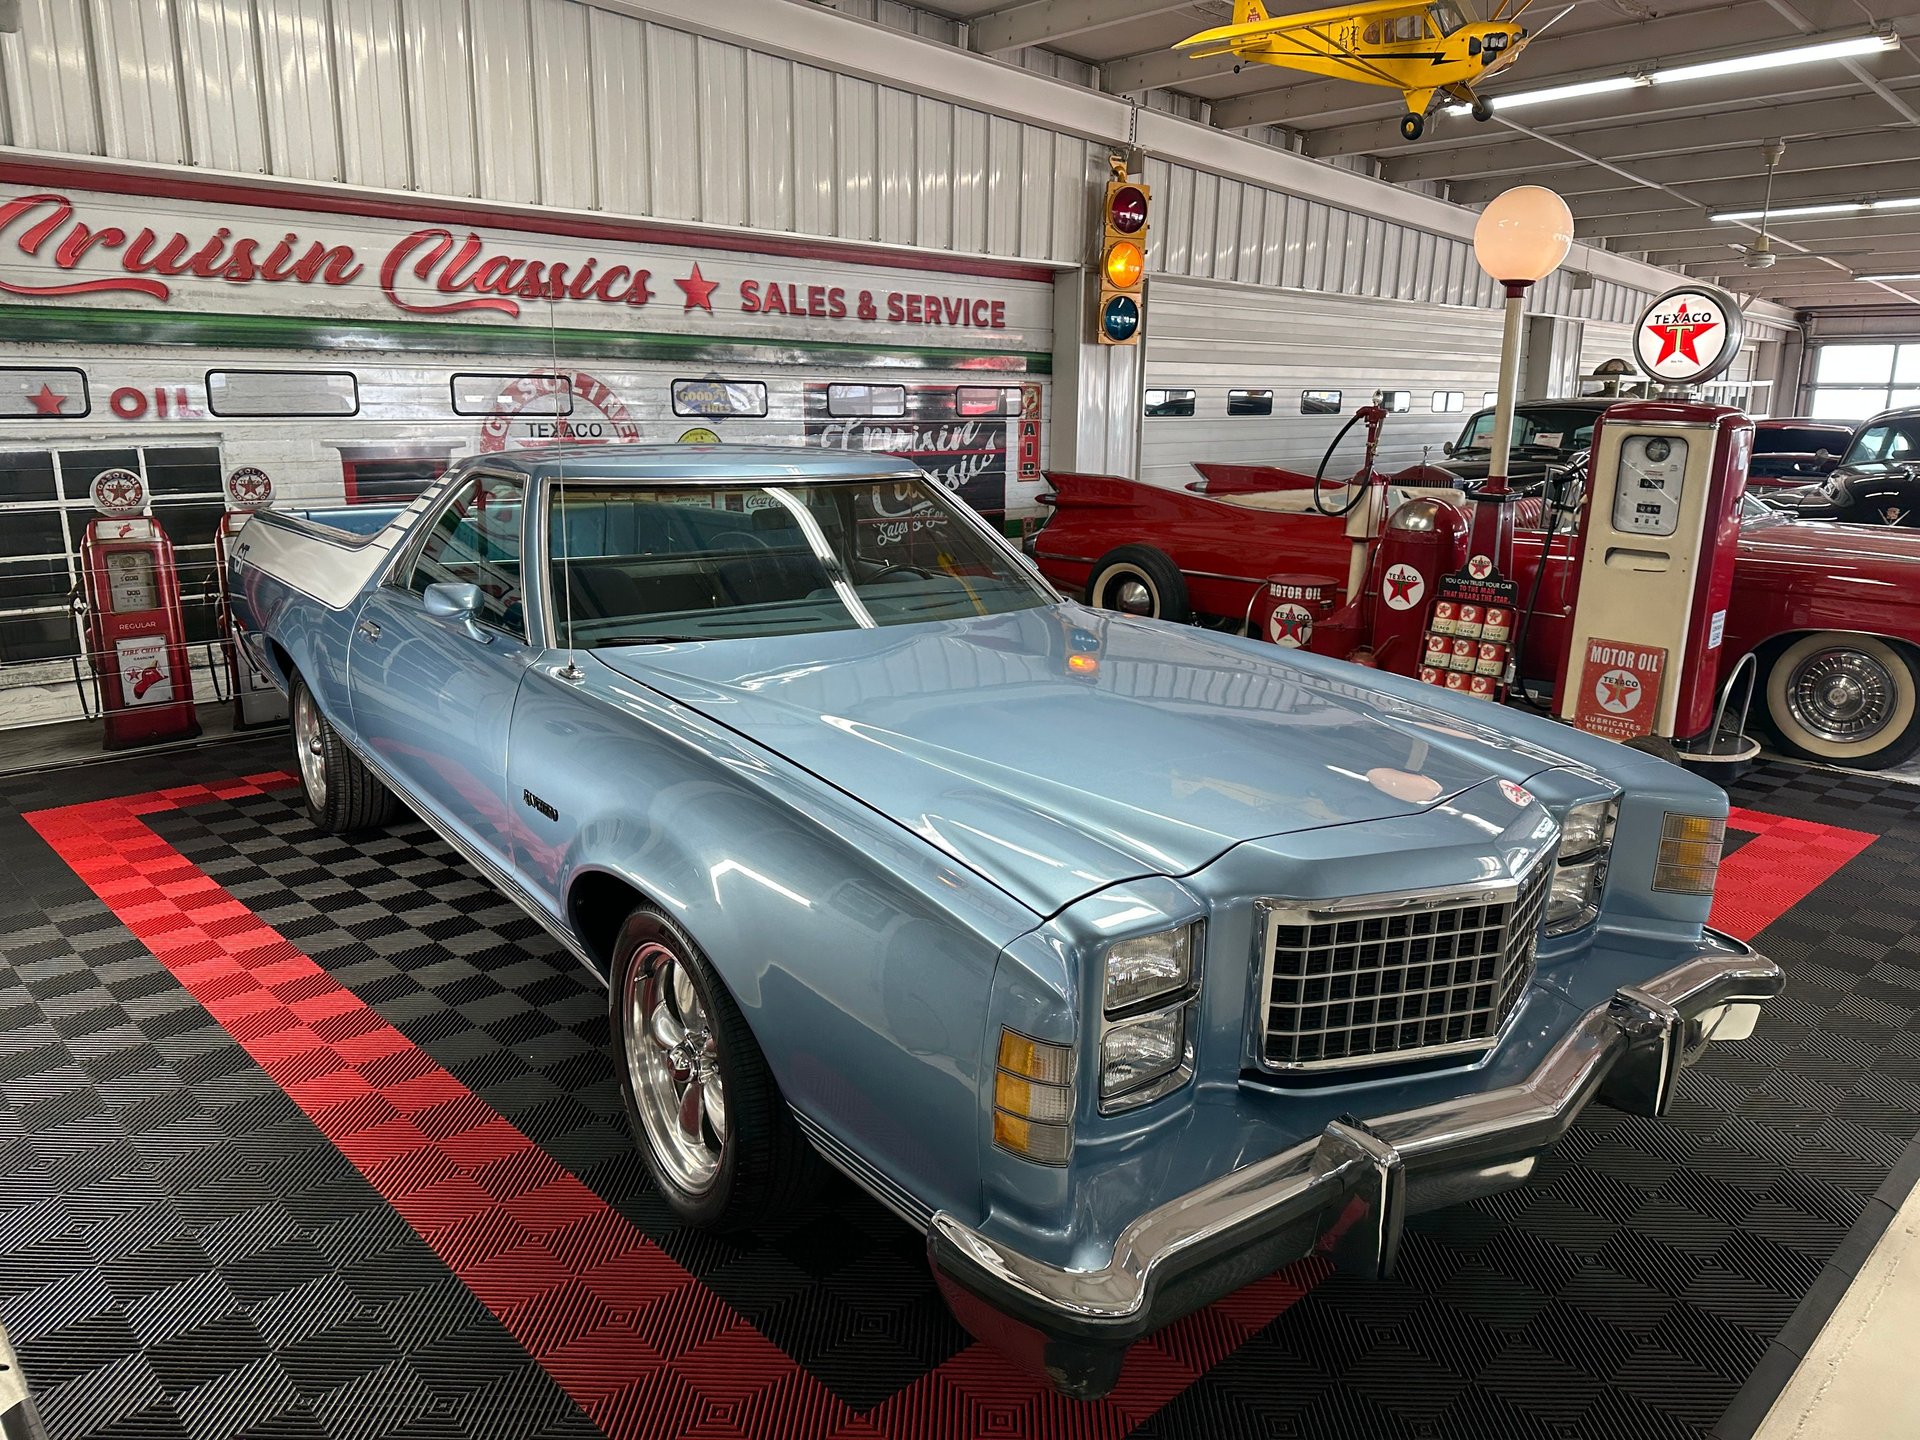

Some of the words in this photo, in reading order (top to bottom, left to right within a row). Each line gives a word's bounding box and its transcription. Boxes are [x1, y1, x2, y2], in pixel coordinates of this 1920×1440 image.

[380, 228, 655, 318] Classics
[740, 279, 846, 319] SALES
[857, 290, 877, 320] &
[888, 292, 1006, 328] SERVICE
[1654, 312, 1712, 324] TEXACO
[110, 386, 203, 419] OIL
[526, 423, 602, 438] TEXACO
[1023, 422, 1036, 475] AIR
[1389, 572, 1418, 581] TEXACO
[1269, 583, 1302, 599] MOTOR
[1305, 587, 1321, 600] OIL
[1480, 587, 1496, 595] MAN
[1485, 581, 1500, 589] YOUR
[1443, 589, 1457, 598] THAT
[1458, 591, 1480, 600] WEARS
[1481, 594, 1492, 602] THE
[1275, 611, 1310, 620] TEXACO
[119, 620, 156, 630] REGULAR
[1590, 645, 1635, 668] MOTOR
[1638, 653, 1658, 672] OIL
[1603, 676, 1638, 687] TEXACO
[1585, 715, 1640, 731] LUBRICATES
[1586, 722, 1637, 738] PERFECTLY
